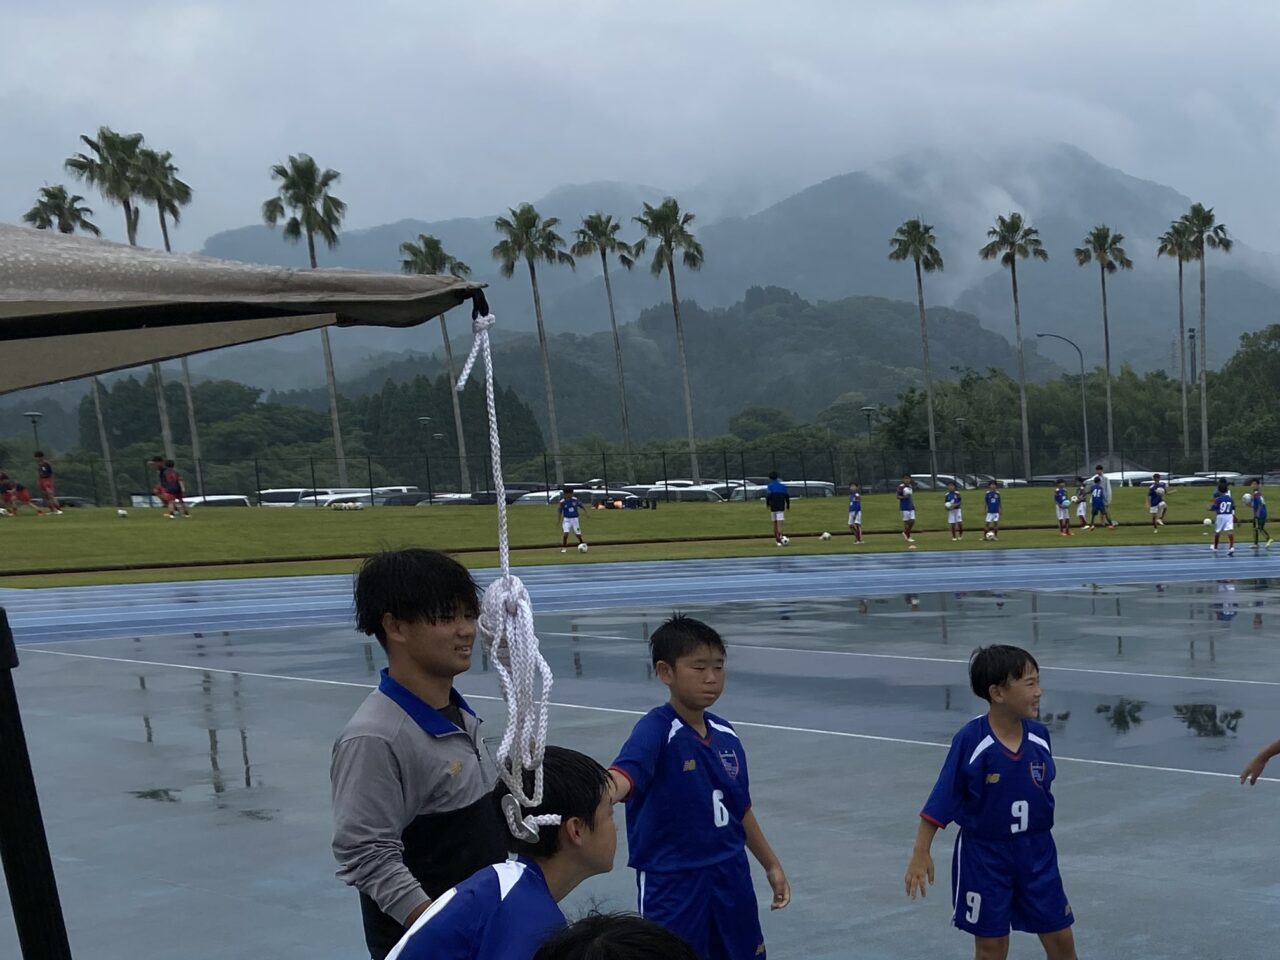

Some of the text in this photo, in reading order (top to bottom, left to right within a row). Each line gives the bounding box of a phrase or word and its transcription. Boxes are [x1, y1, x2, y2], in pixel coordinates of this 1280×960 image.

[1219, 501, 1232, 513] 97
[712, 789, 730, 828] 6
[1010, 799, 1030, 834] 9
[965, 891, 981, 925] 9
